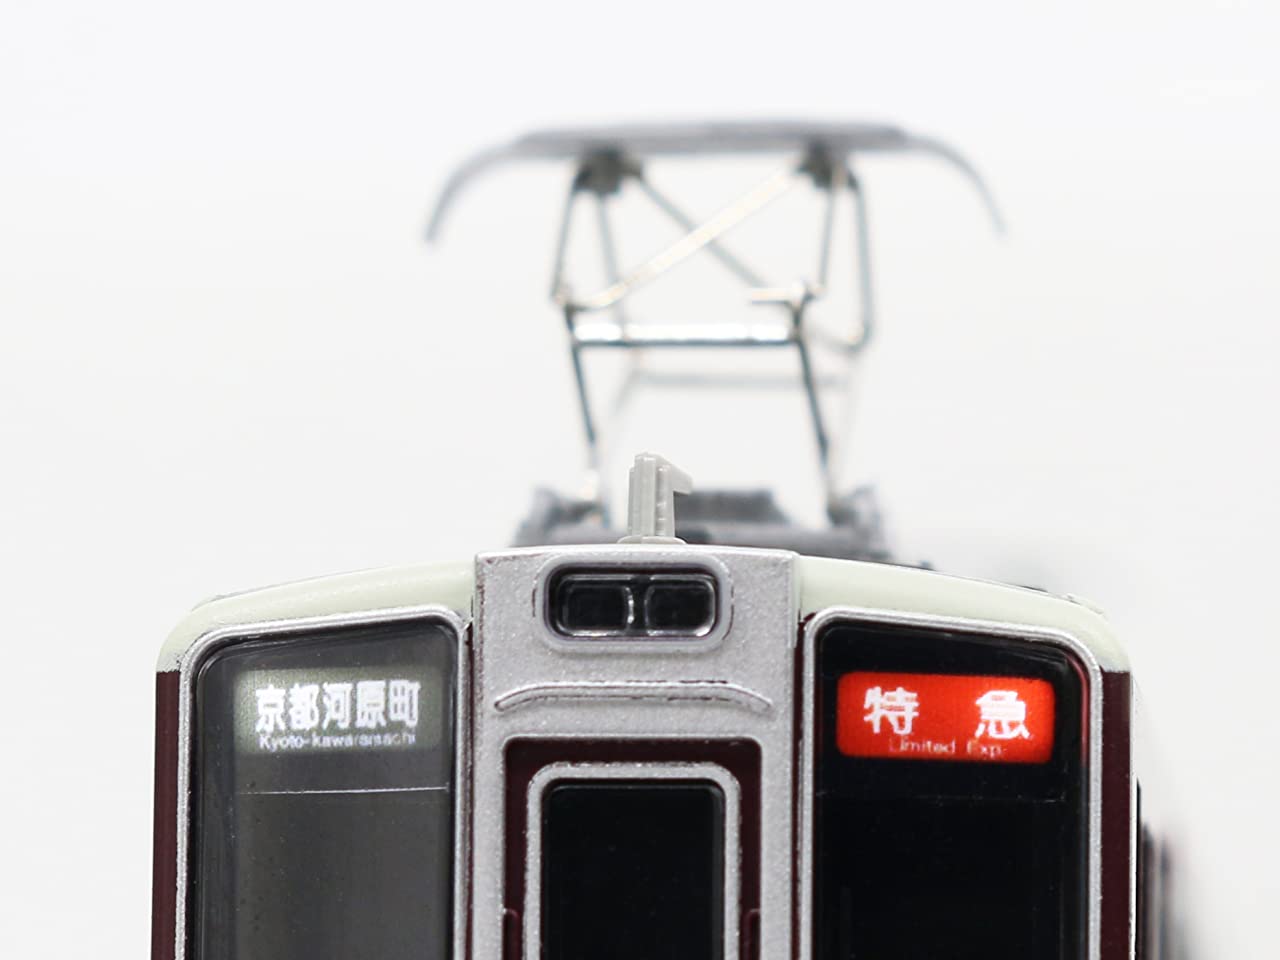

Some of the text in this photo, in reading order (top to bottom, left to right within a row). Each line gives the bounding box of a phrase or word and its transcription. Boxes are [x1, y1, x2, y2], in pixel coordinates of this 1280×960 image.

[255, 680, 421, 732] 京都河原町
